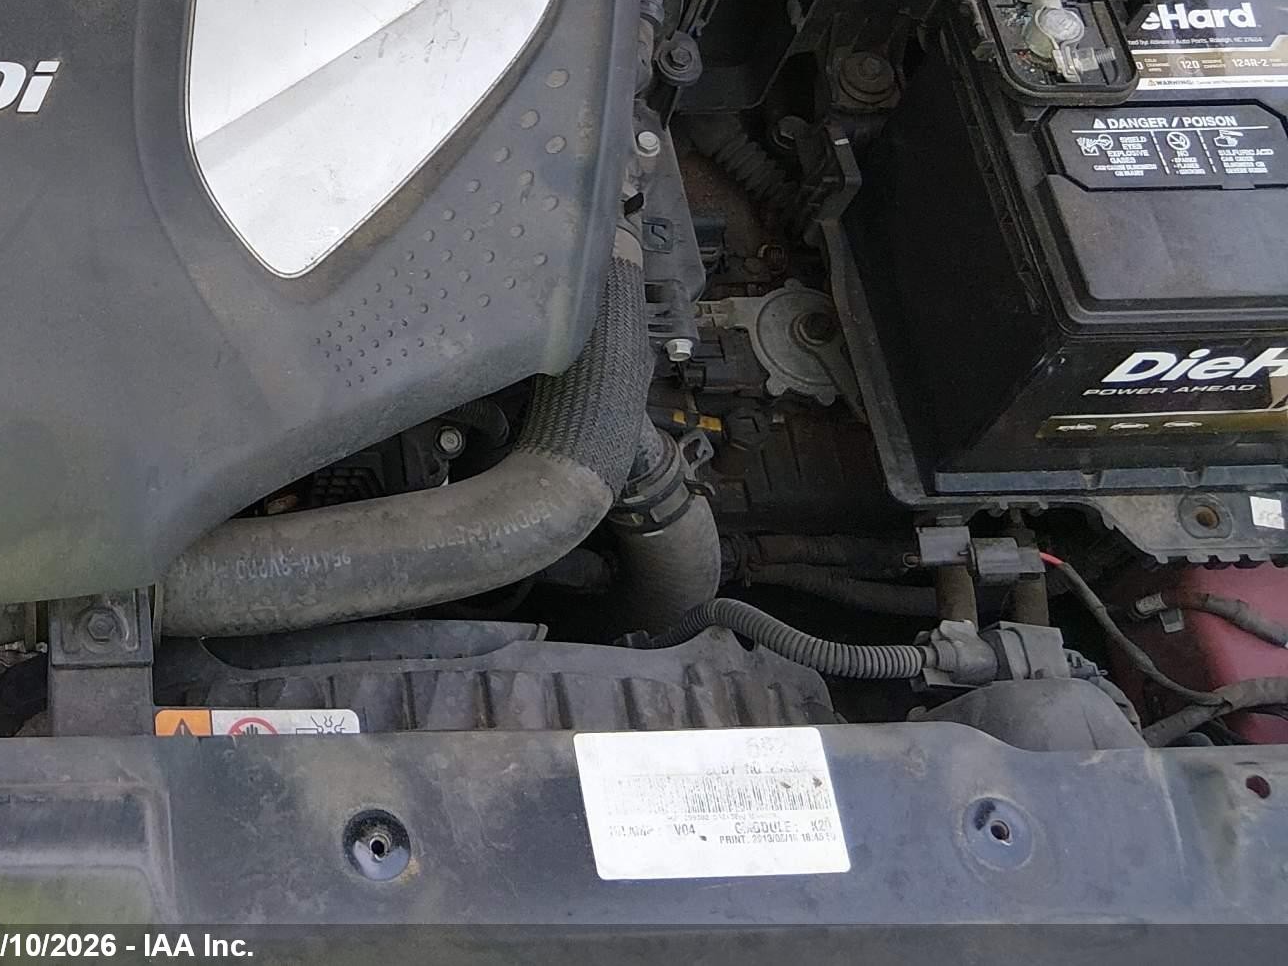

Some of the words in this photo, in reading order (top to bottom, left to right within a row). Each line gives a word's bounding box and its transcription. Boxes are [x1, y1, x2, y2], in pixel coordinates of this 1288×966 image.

[1180, 60, 1200, 69] 120
[1108, 117, 1168, 129] DANGER
[1182, 116, 1238, 127] POISON
[1082, 387, 1168, 397] POWER
[1172, 384, 1257, 394] AHEAD
[673, 823, 696, 836] V04
